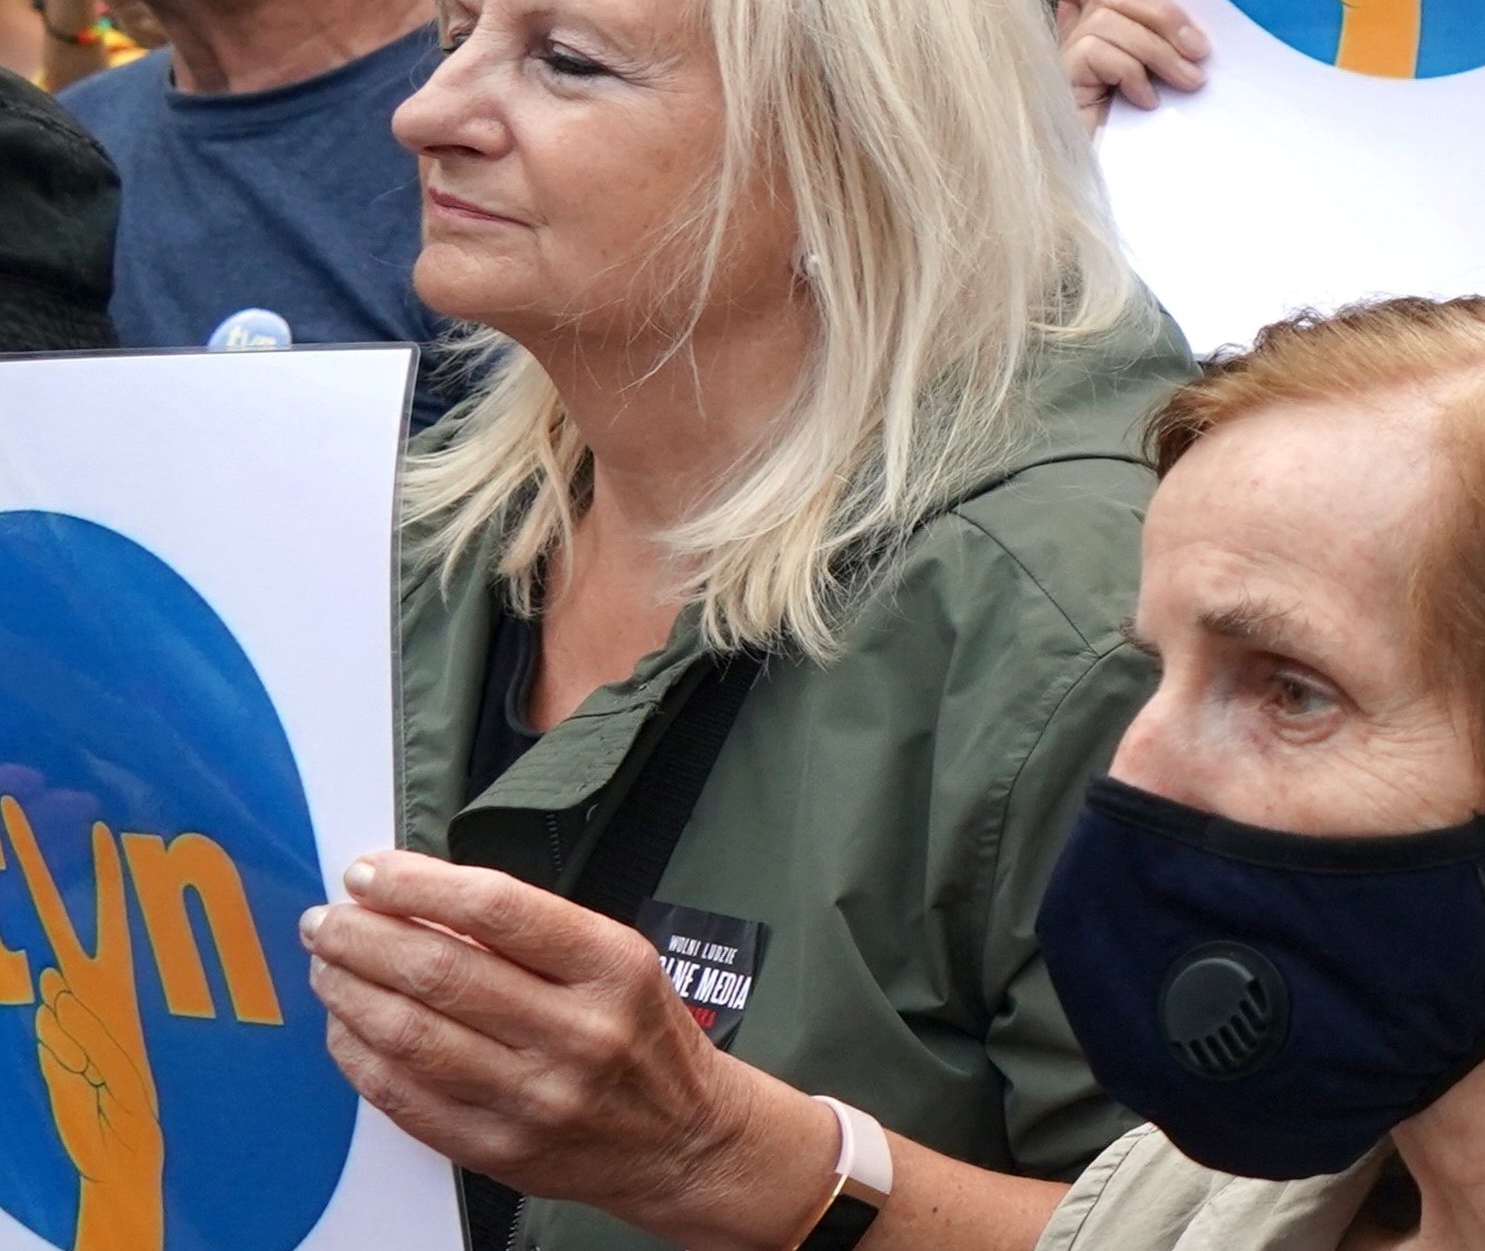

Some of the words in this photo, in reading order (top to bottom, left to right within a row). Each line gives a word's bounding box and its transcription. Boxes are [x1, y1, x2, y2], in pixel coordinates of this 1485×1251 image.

[669, 935, 700, 956] WOLNI
[702, 942, 738, 964] LUDZIE
[695, 968, 752, 1009] MEDIA
